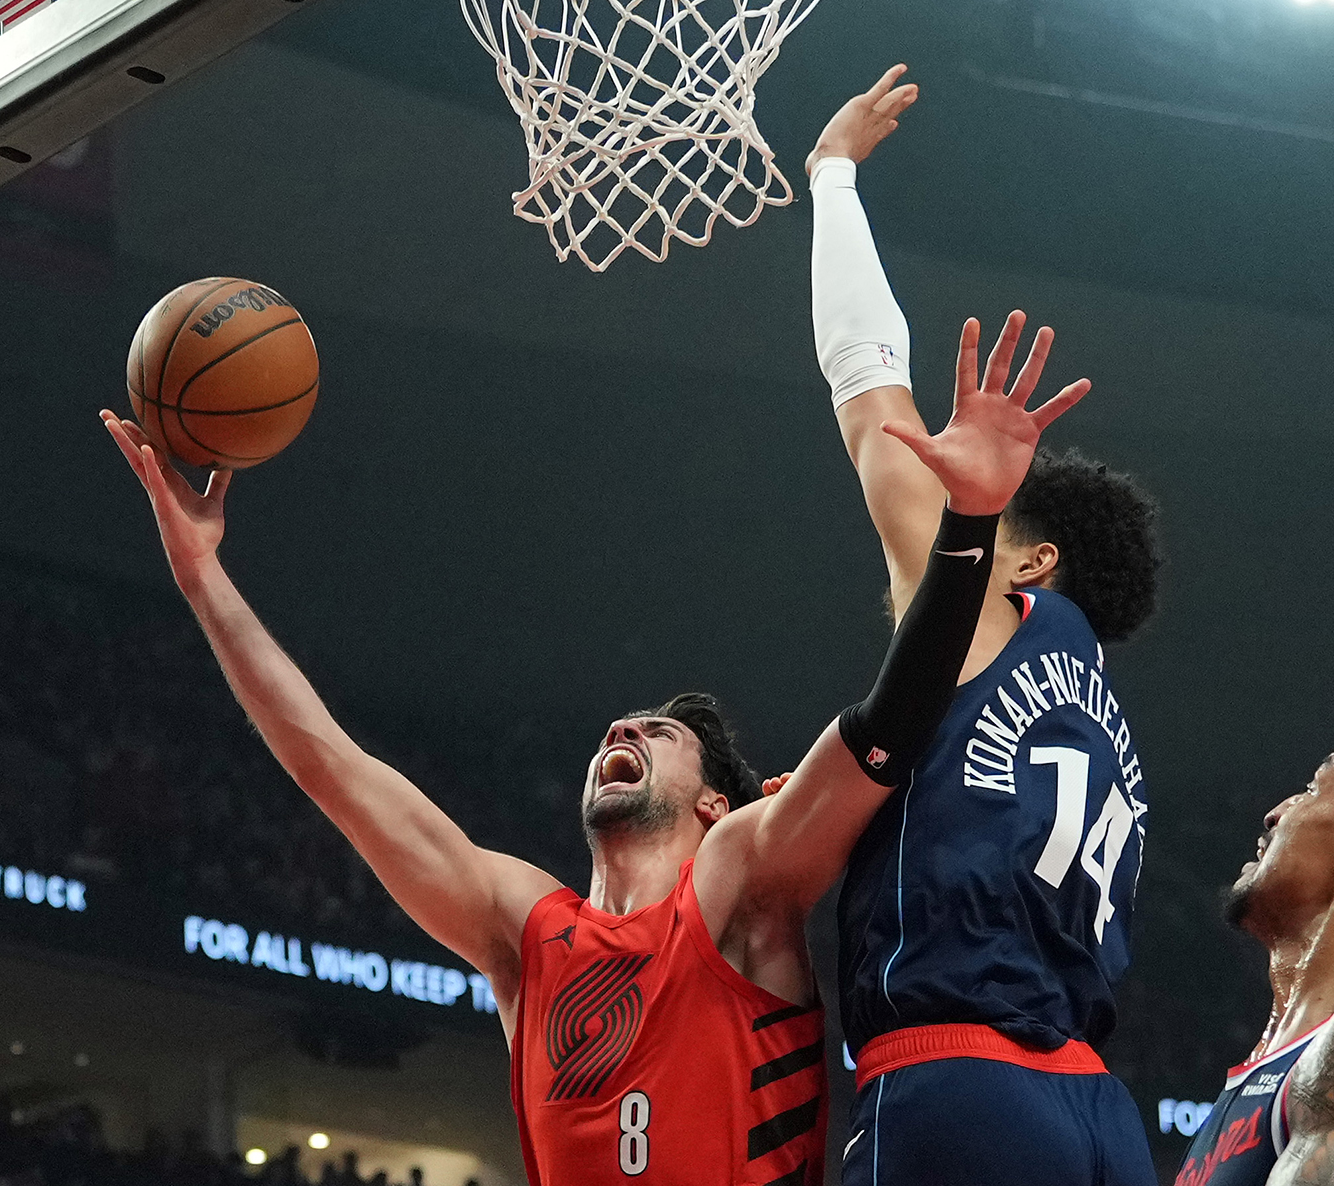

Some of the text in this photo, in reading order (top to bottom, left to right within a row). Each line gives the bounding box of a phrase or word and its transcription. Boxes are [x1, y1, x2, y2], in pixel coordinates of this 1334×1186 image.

[964, 651, 1148, 890] KONAN-NIEDERHA
[1029, 746, 1134, 945] 14
[184, 915, 249, 964] FOR
[251, 930, 311, 977] ALL
[311, 941, 389, 992] WHO
[390, 958, 467, 1006] KEEP
[618, 1090, 651, 1176] 8
